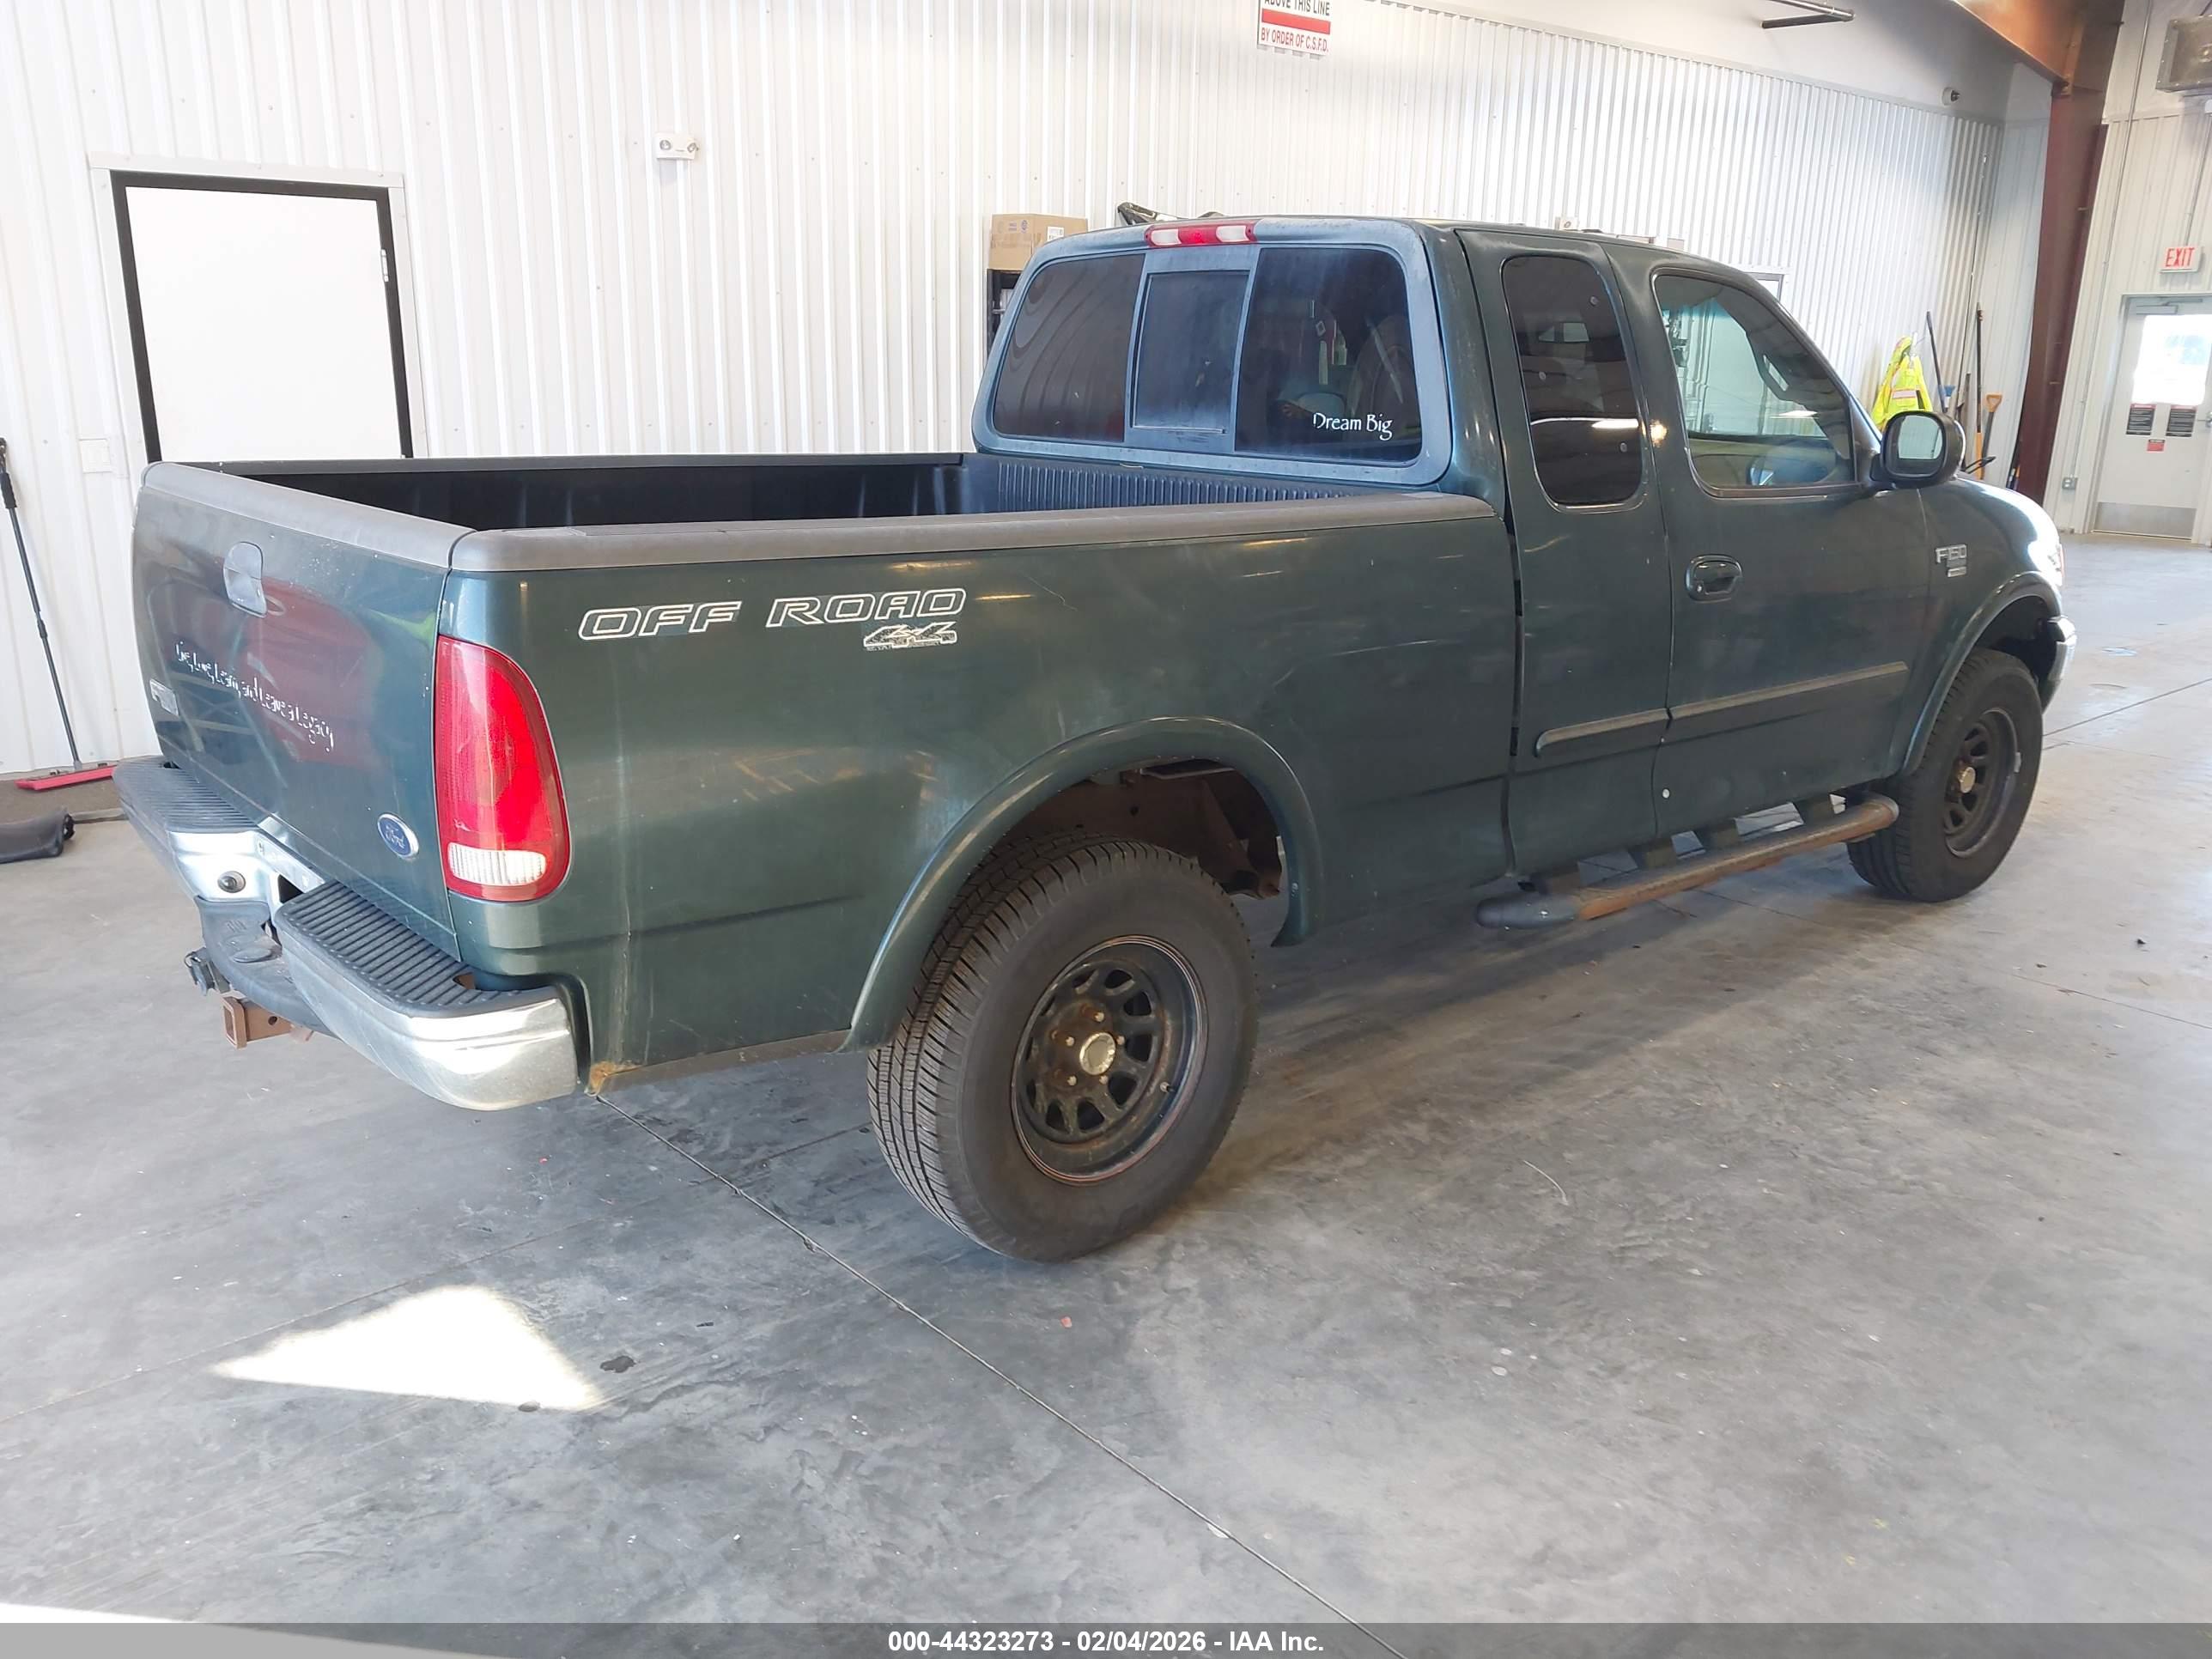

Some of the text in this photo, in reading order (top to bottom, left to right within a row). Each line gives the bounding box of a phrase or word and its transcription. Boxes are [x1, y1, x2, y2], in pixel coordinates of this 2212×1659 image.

[1294, 0, 1310, 12] THIS
[1313, 0, 1330, 16] LINE
[1261, 27, 1270, 41] BY
[1271, 30, 1294, 46] ORDER
[1295, 33, 1304, 48] OF
[2165, 246, 2195, 267] EXIT
[1313, 412, 1393, 441] Dream Big
[578, 587, 967, 641] OFF ROAD
